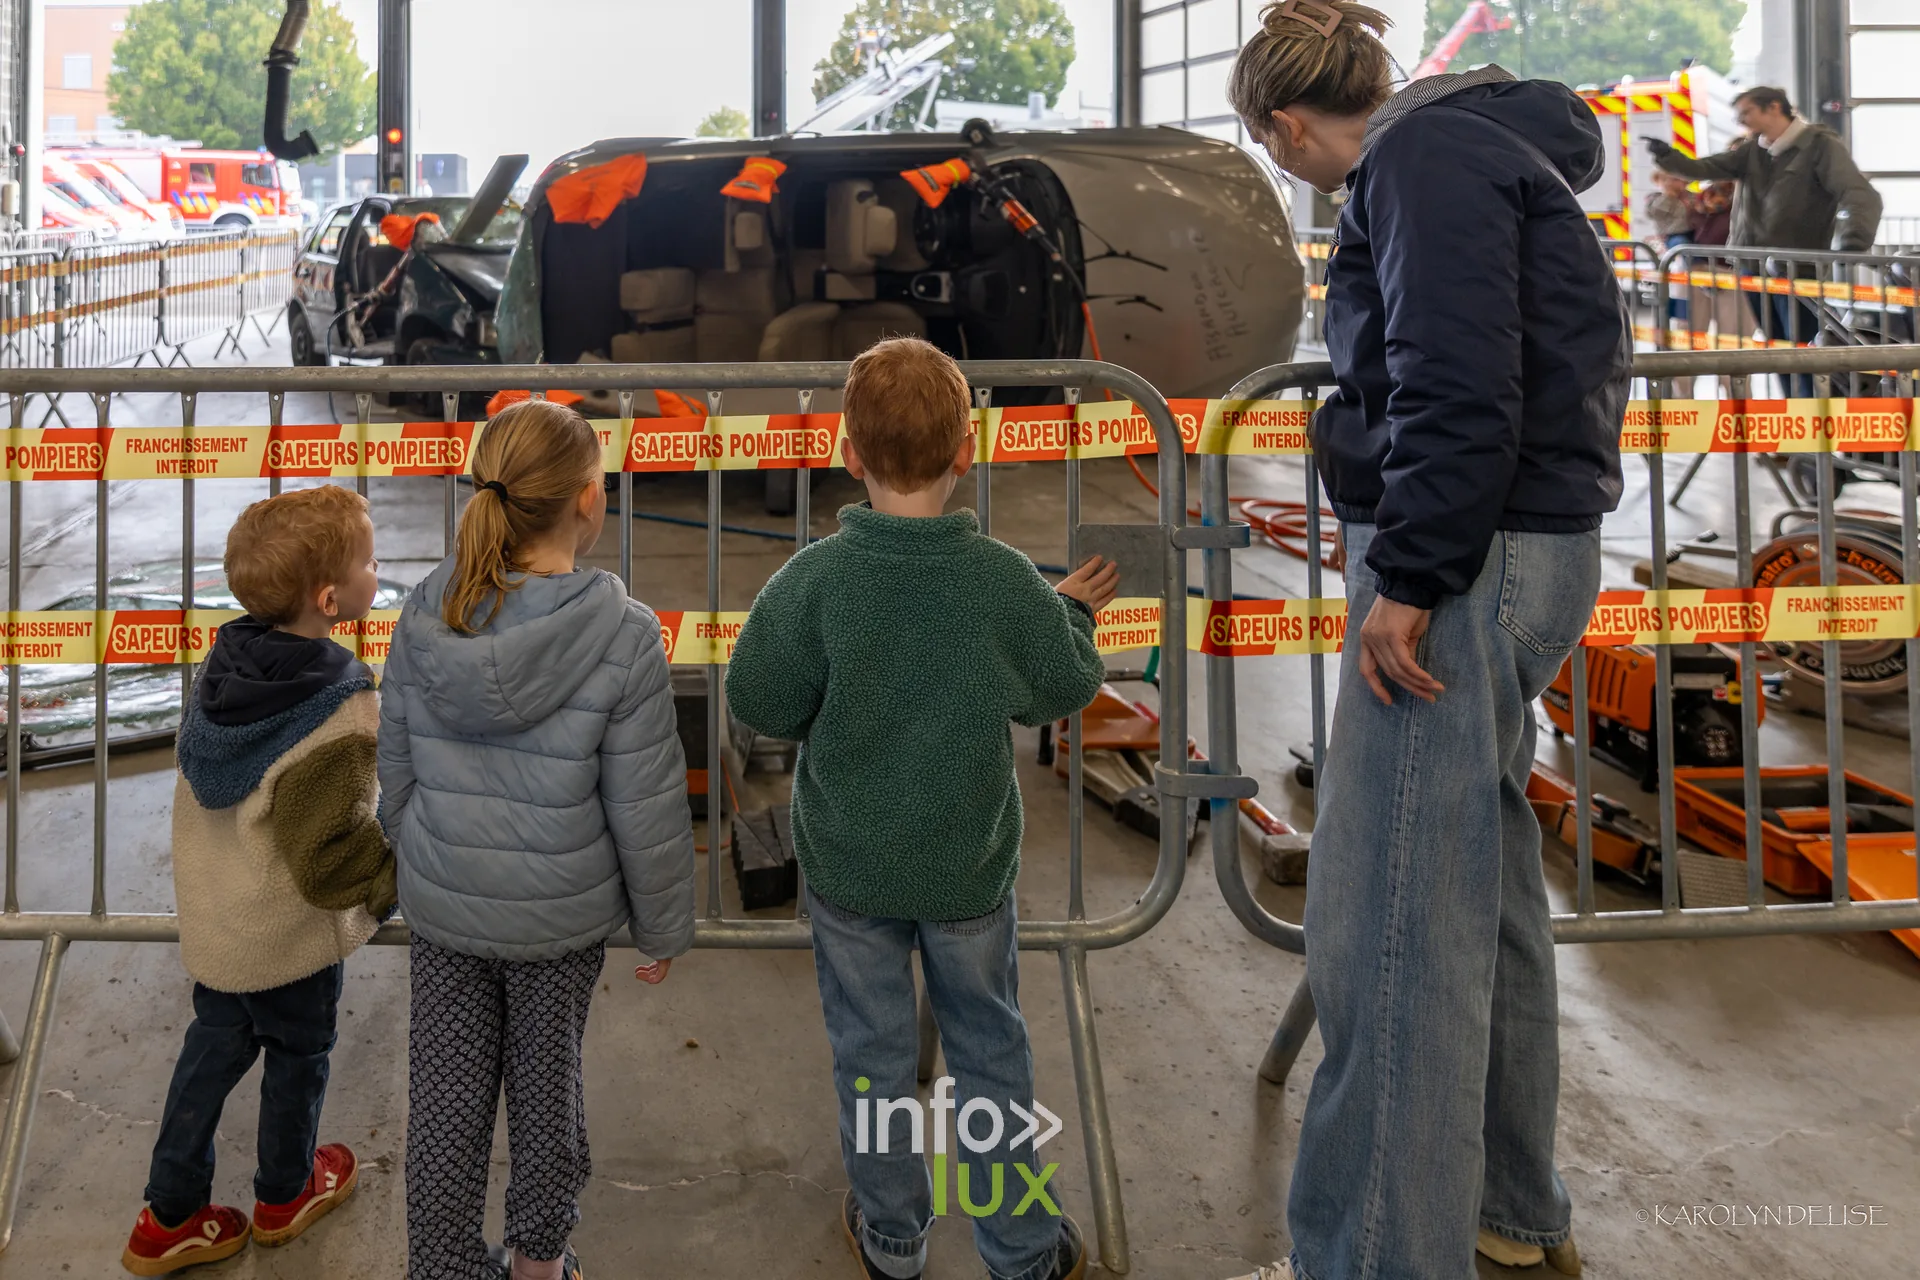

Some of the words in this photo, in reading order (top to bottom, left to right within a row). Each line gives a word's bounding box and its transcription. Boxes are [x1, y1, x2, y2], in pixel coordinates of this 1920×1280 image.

[1222, 411, 1312, 427] FRANCHISSE
[1623, 410, 1698, 426] HISSEMENT
[1003, 421, 1093, 449] SAPEURS
[1098, 416, 1196, 445] POMPS
[1719, 414, 1806, 441] SAPEURS
[1812, 414, 1905, 440] POMPIERS
[126, 437, 248, 454] FRANCHISSEMENT
[633, 434, 723, 460] SAPEURS
[730, 432, 829, 457] POMPIERS
[1253, 432, 1312, 449] INTERDI
[1618, 432, 1670, 448] TERDIT
[6, 443, 103, 471] POMPIERS
[270, 441, 358, 468] SAPEURS
[364, 438, 464, 466] POMPIERS
[156, 459, 218, 474] INTERDIT
[1787, 596, 1905, 613] FRANCHISSEMENT
[1094, 606, 1160, 626] NCHISSEM
[1588, 606, 1663, 632] APEURS
[1668, 604, 1765, 631] POMPIERS
[0, 621, 92, 637] NCHISSEMENT
[331, 620, 398, 636] FRANCHIS
[1213, 615, 1303, 643] SAPEURS
[1817, 618, 1878, 634] INTERDIT
[115, 626, 203, 652] SAPEURS
[1097, 628, 1157, 648] INTERDIT
[1, 643, 63, 658] INTERDIT
